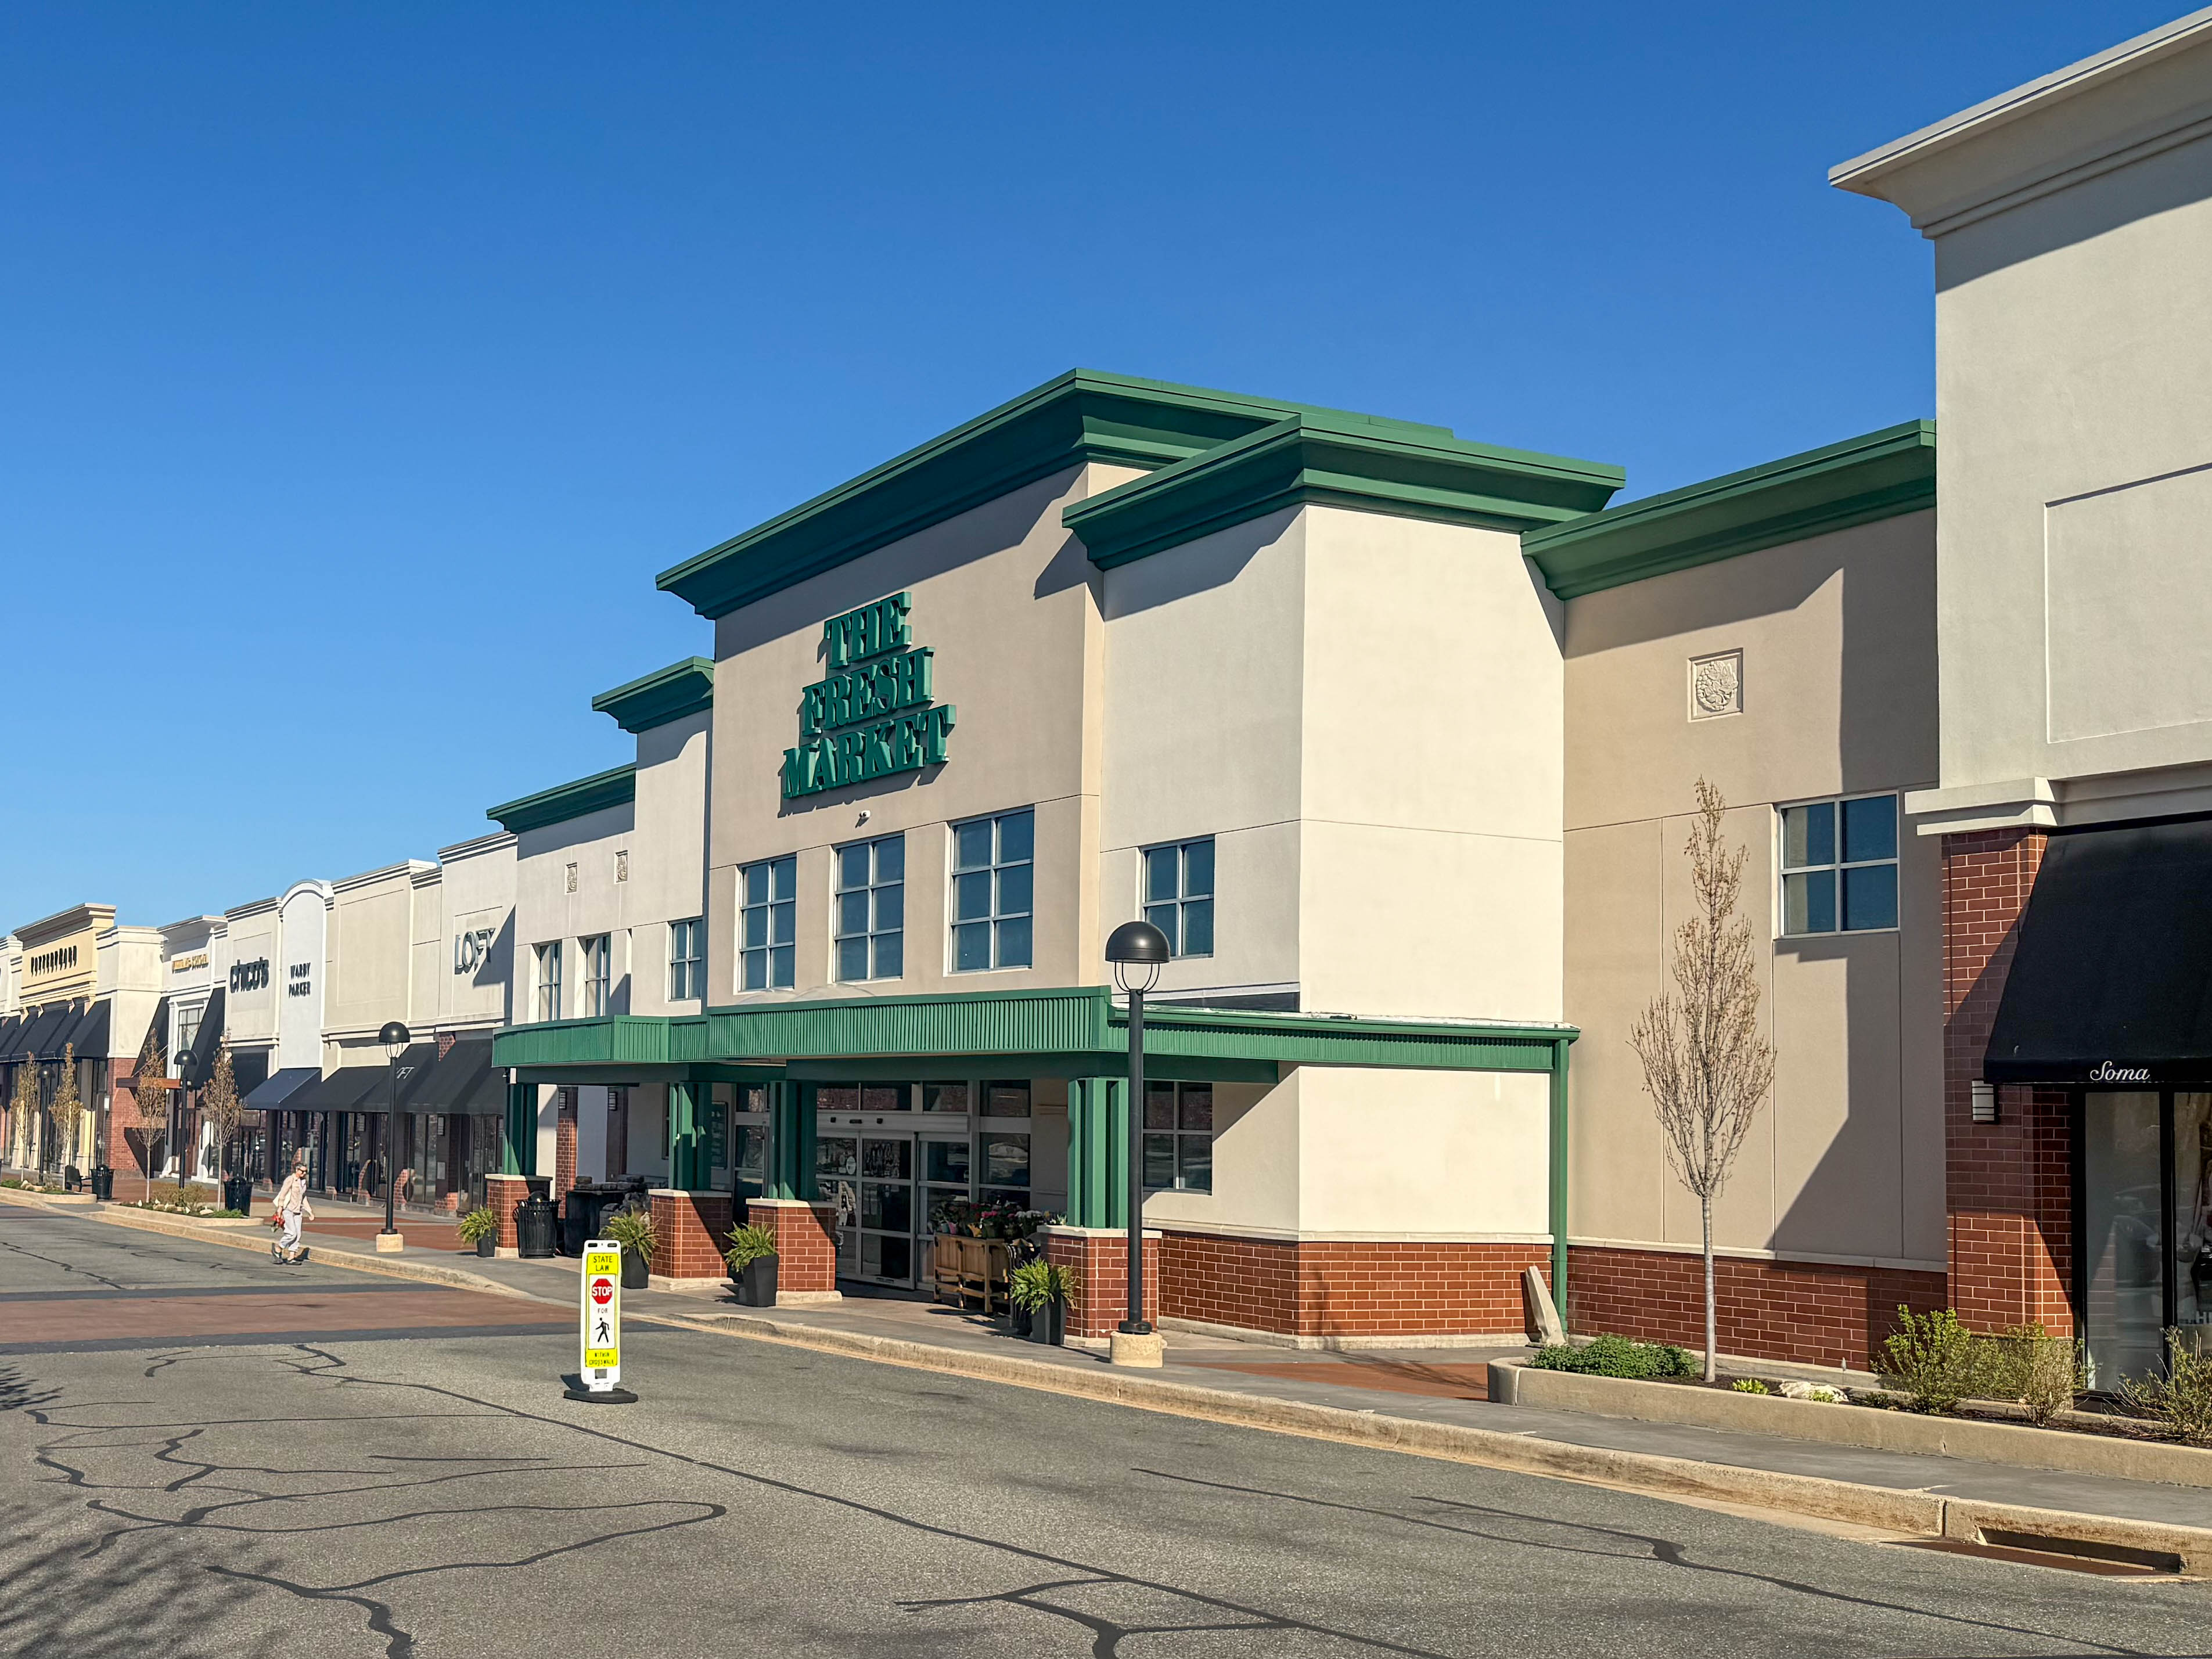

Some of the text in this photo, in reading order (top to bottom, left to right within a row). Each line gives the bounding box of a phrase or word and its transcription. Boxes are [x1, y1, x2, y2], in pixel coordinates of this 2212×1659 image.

[824, 592, 912, 670] THE
[802, 646, 936, 737] FRESH
[783, 704, 956, 799] MARKET
[455, 927, 496, 970] LOFT
[2090, 1060, 2150, 1081] Soma
[592, 1286, 613, 1296] STOP
